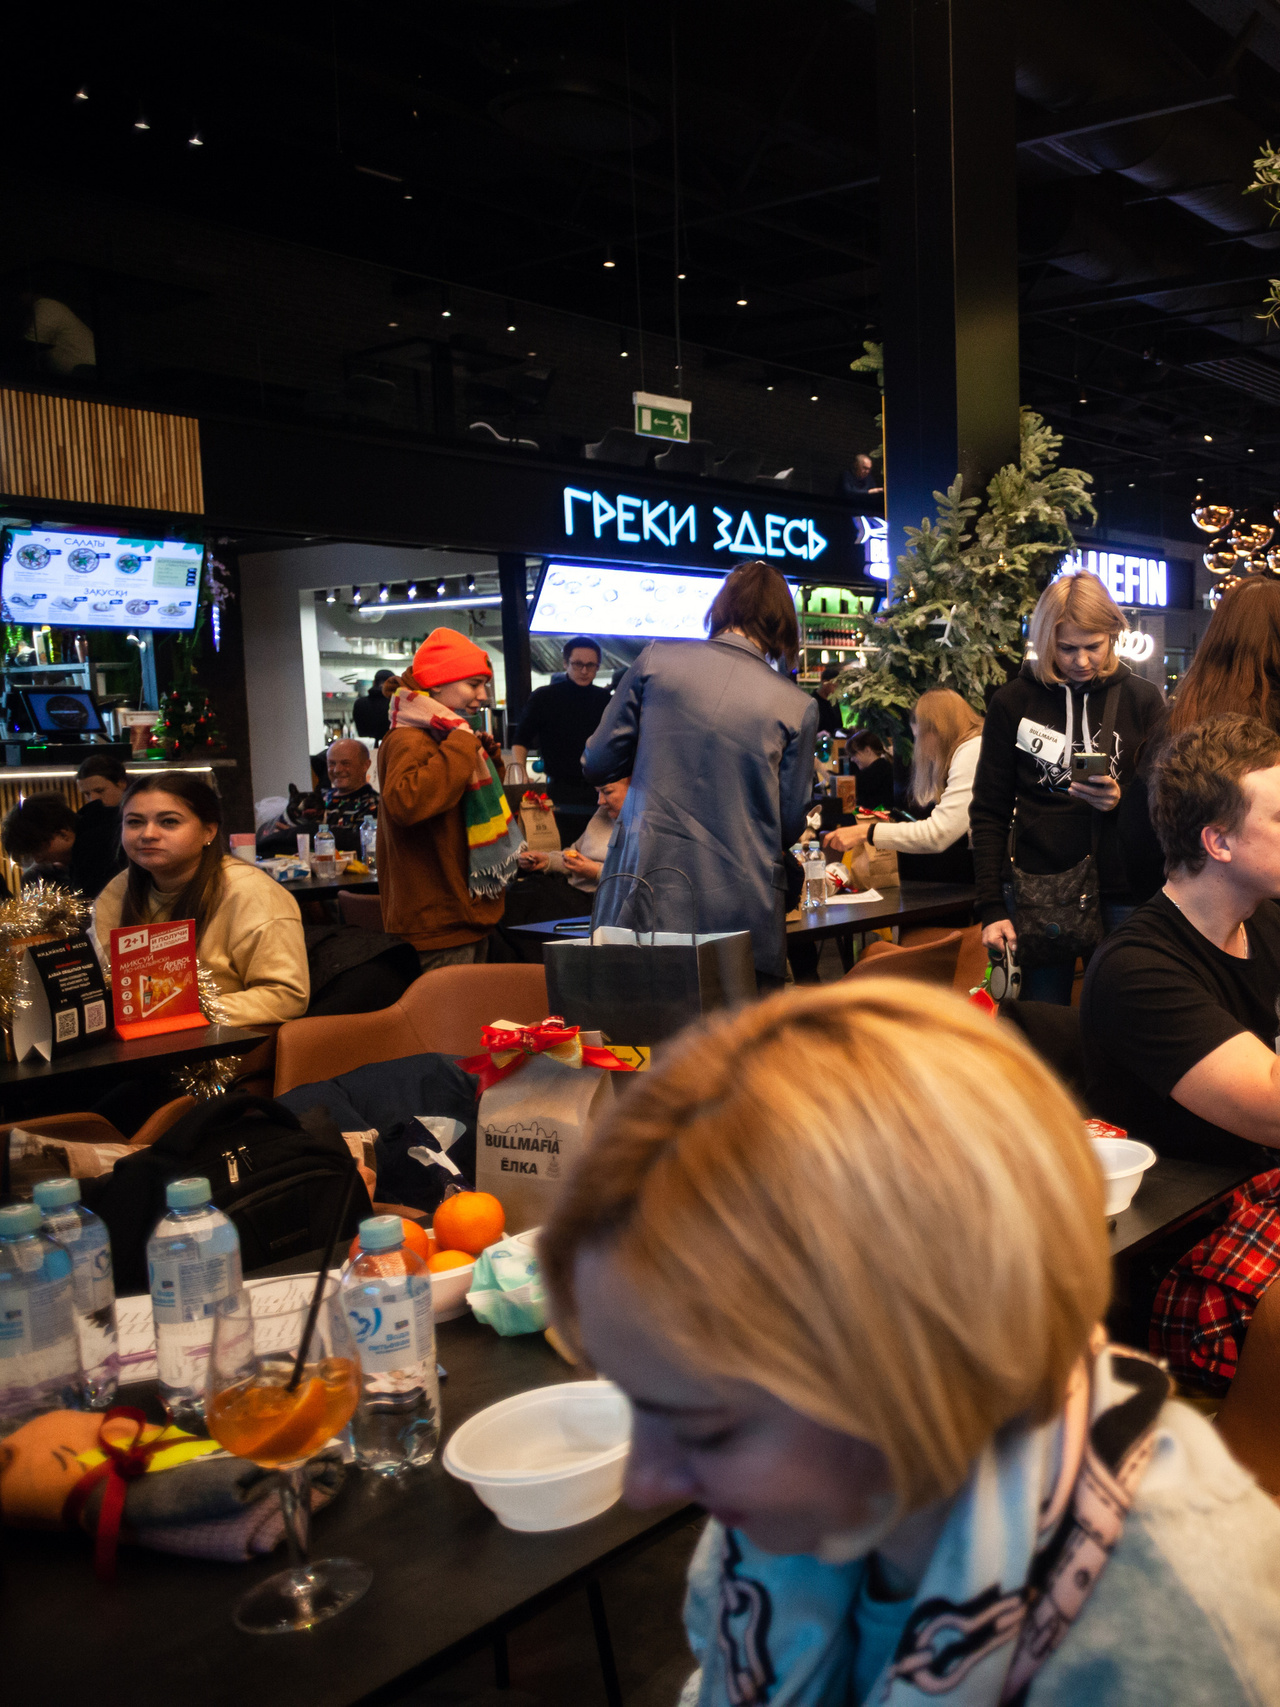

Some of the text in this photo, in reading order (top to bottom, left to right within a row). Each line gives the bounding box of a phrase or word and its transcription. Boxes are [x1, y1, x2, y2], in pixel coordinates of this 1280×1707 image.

[563, 486, 697, 547] ГРЕКИ
[713, 505, 828, 561] ЗДЕСЬ
[64, 537, 105, 548] САЛАТЫ
[83, 587, 128, 598] ЗАКУСКИ
[1029, 727, 1058, 744] BULLMAFIA
[1030, 737, 1044, 754] 9
[123, 934, 145, 949] 2+1
[158, 929, 188, 943] ПОЛУЧИ
[72, 941, 88, 949] МЕСТО
[119, 952, 154, 971] МИКСУЙ
[485, 1133, 560, 1154] BULLMAFIA
[500, 1157, 538, 1175] ЁЛКА
